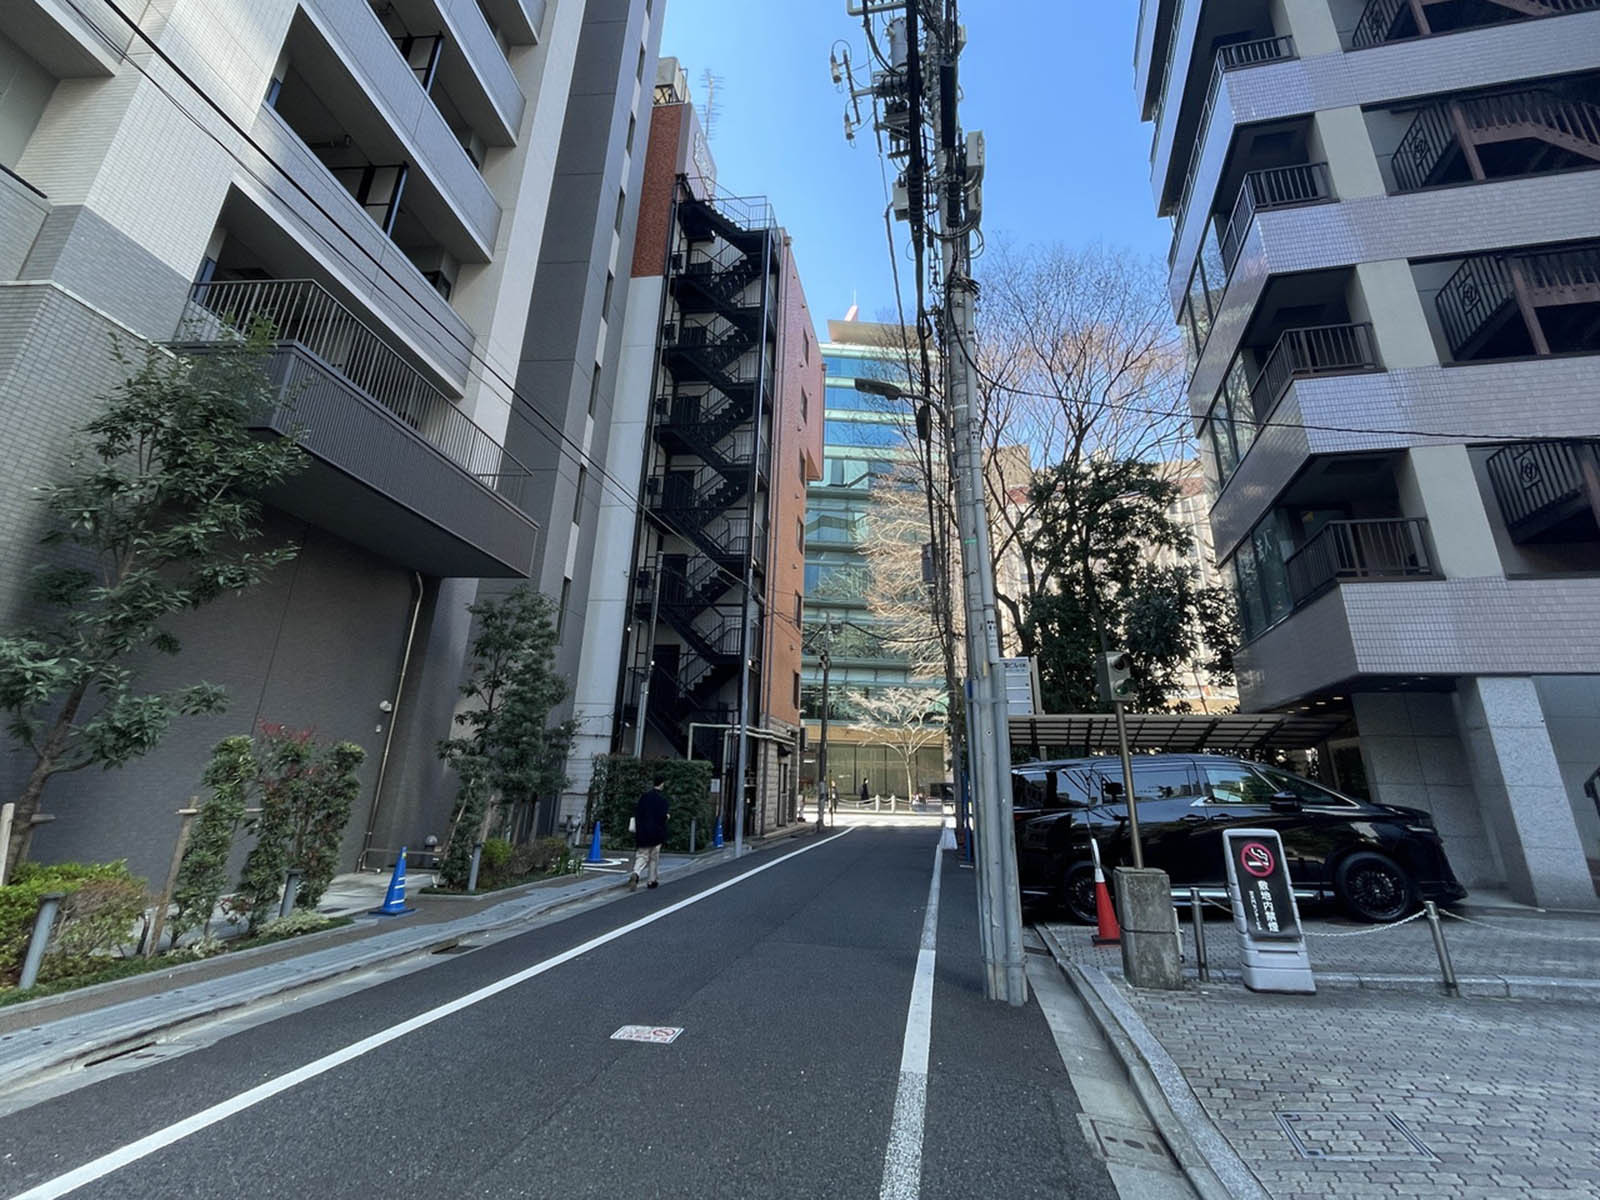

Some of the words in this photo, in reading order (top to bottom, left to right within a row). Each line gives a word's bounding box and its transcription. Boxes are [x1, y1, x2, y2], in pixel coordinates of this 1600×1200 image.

[1257, 880, 1279, 932] 敷地内禁煙
